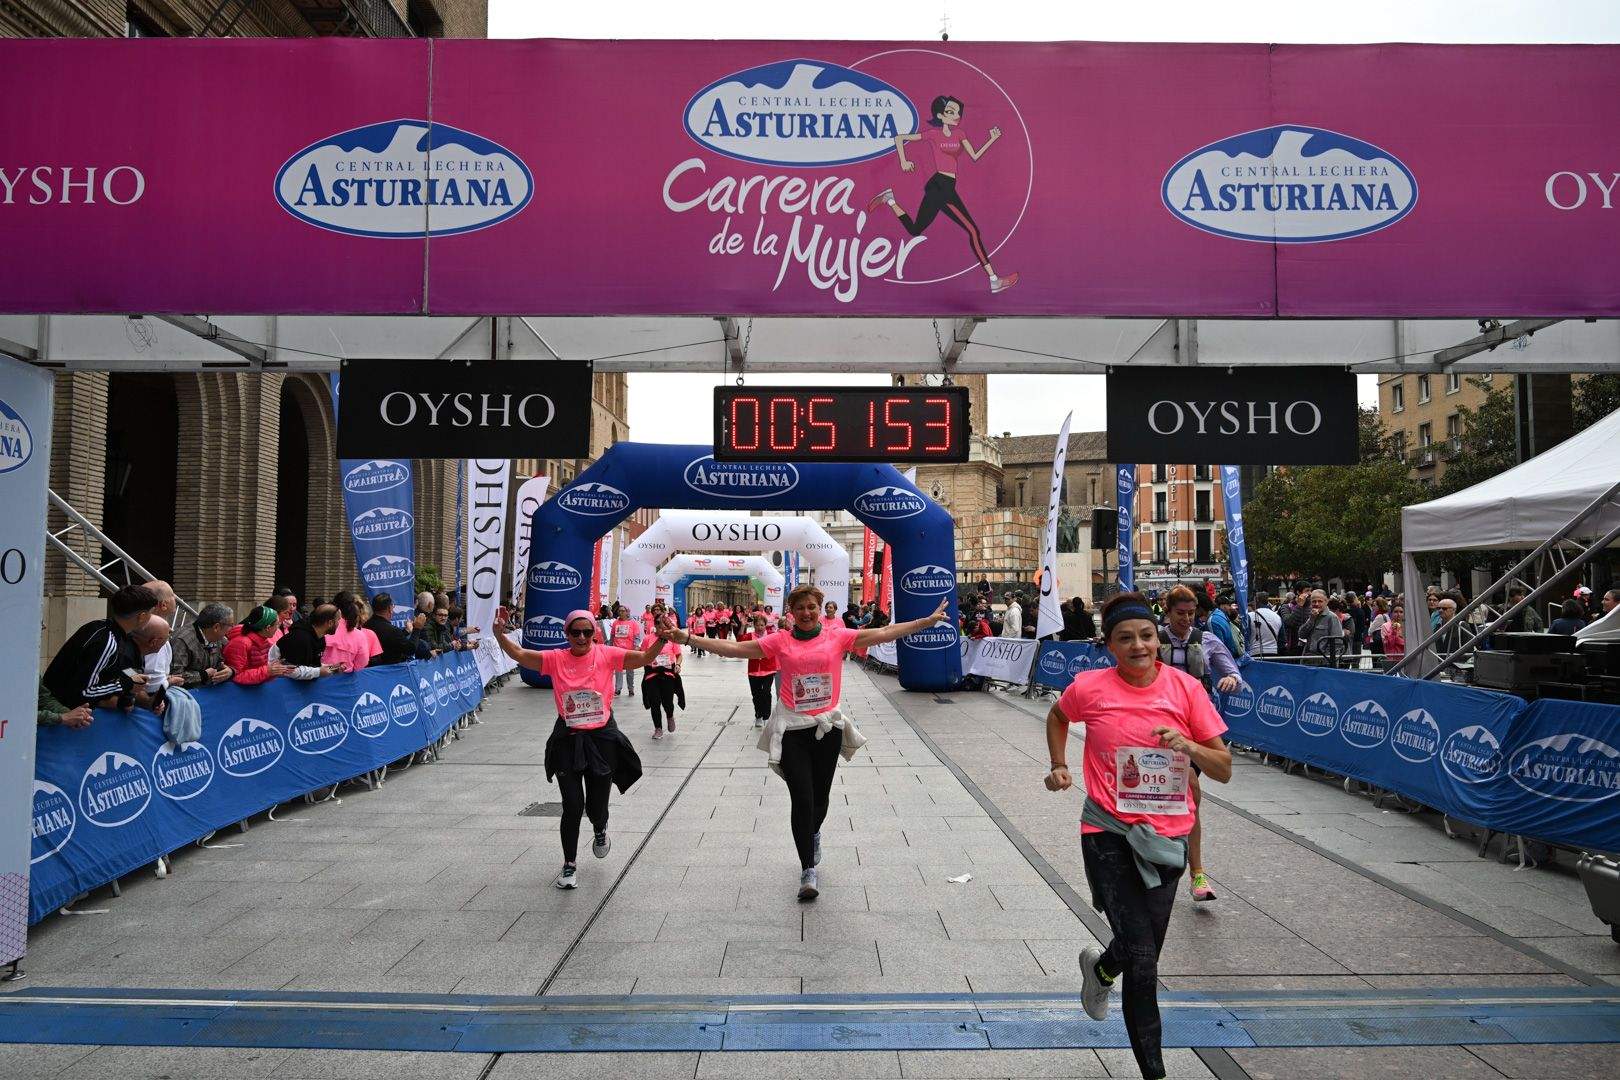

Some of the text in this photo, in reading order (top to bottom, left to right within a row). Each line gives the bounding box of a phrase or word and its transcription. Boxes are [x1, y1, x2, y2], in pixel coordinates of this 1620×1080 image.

[738, 96, 893, 108] CENTRAL LECHERA
[701, 98, 899, 139] ASTURIANA
[335, 160, 505, 171] CENTRAL LECHERA
[1221, 165, 1389, 177] CENTRAL LECHERA
[294, 163, 513, 207] ASTURIANA
[662, 158, 856, 215] Carrera
[1182, 168, 1399, 212] ASTURIANA
[708, 210, 927, 302] de la Mujer
[380, 391, 555, 428] OYSHO
[1148, 400, 1321, 435] OYSHO
[692, 464, 791, 486] ASTURIANA
[562, 495, 624, 509] ASTURIANA
[860, 499, 921, 512] ASTURIANA
[692, 523, 781, 541] OYSHO
[805, 542, 833, 550] OYSHO
[529, 571, 577, 586] ASTURIANA
[904, 577, 953, 589] ASTURIANA
[905, 634, 955, 643] ASTURIANA
[982, 640, 1023, 662] OYSHO
[1258, 697, 1291, 719] ASTURIANA
[1300, 705, 1334, 728] ASTURIANA
[294, 722, 346, 747] ASTURIANA
[1342, 714, 1385, 739] ASTURIANA
[224, 739, 281, 768] ASTURIANA
[157, 760, 211, 789] ASTURIANA
[1142, 773, 1166, 784] 016
[87, 778, 149, 816] ASTURIANA
